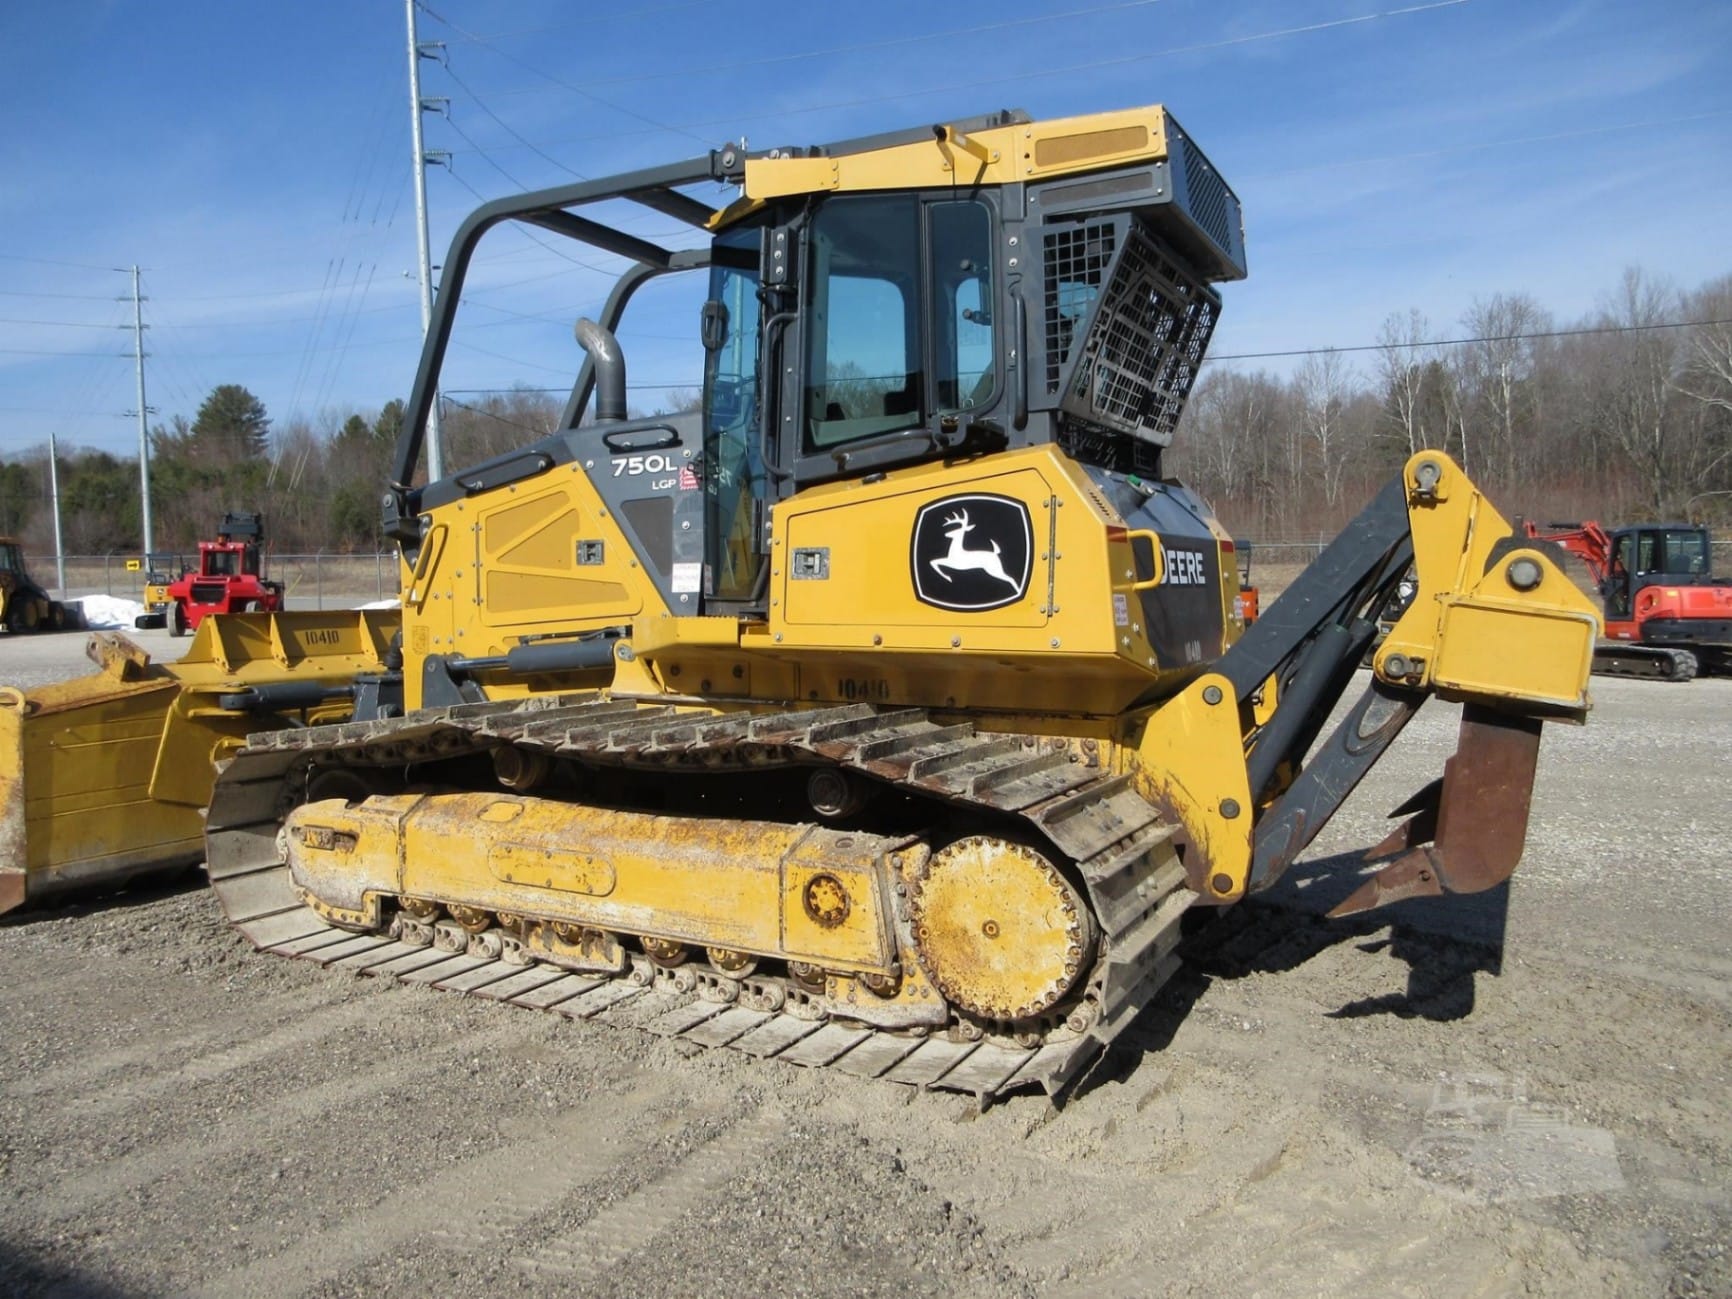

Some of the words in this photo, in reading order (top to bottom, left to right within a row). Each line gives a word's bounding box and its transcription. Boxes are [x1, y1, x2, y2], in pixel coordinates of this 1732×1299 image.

[611, 454, 678, 478] 750L
[652, 479, 677, 491] LGP
[305, 630, 340, 646] 10410
